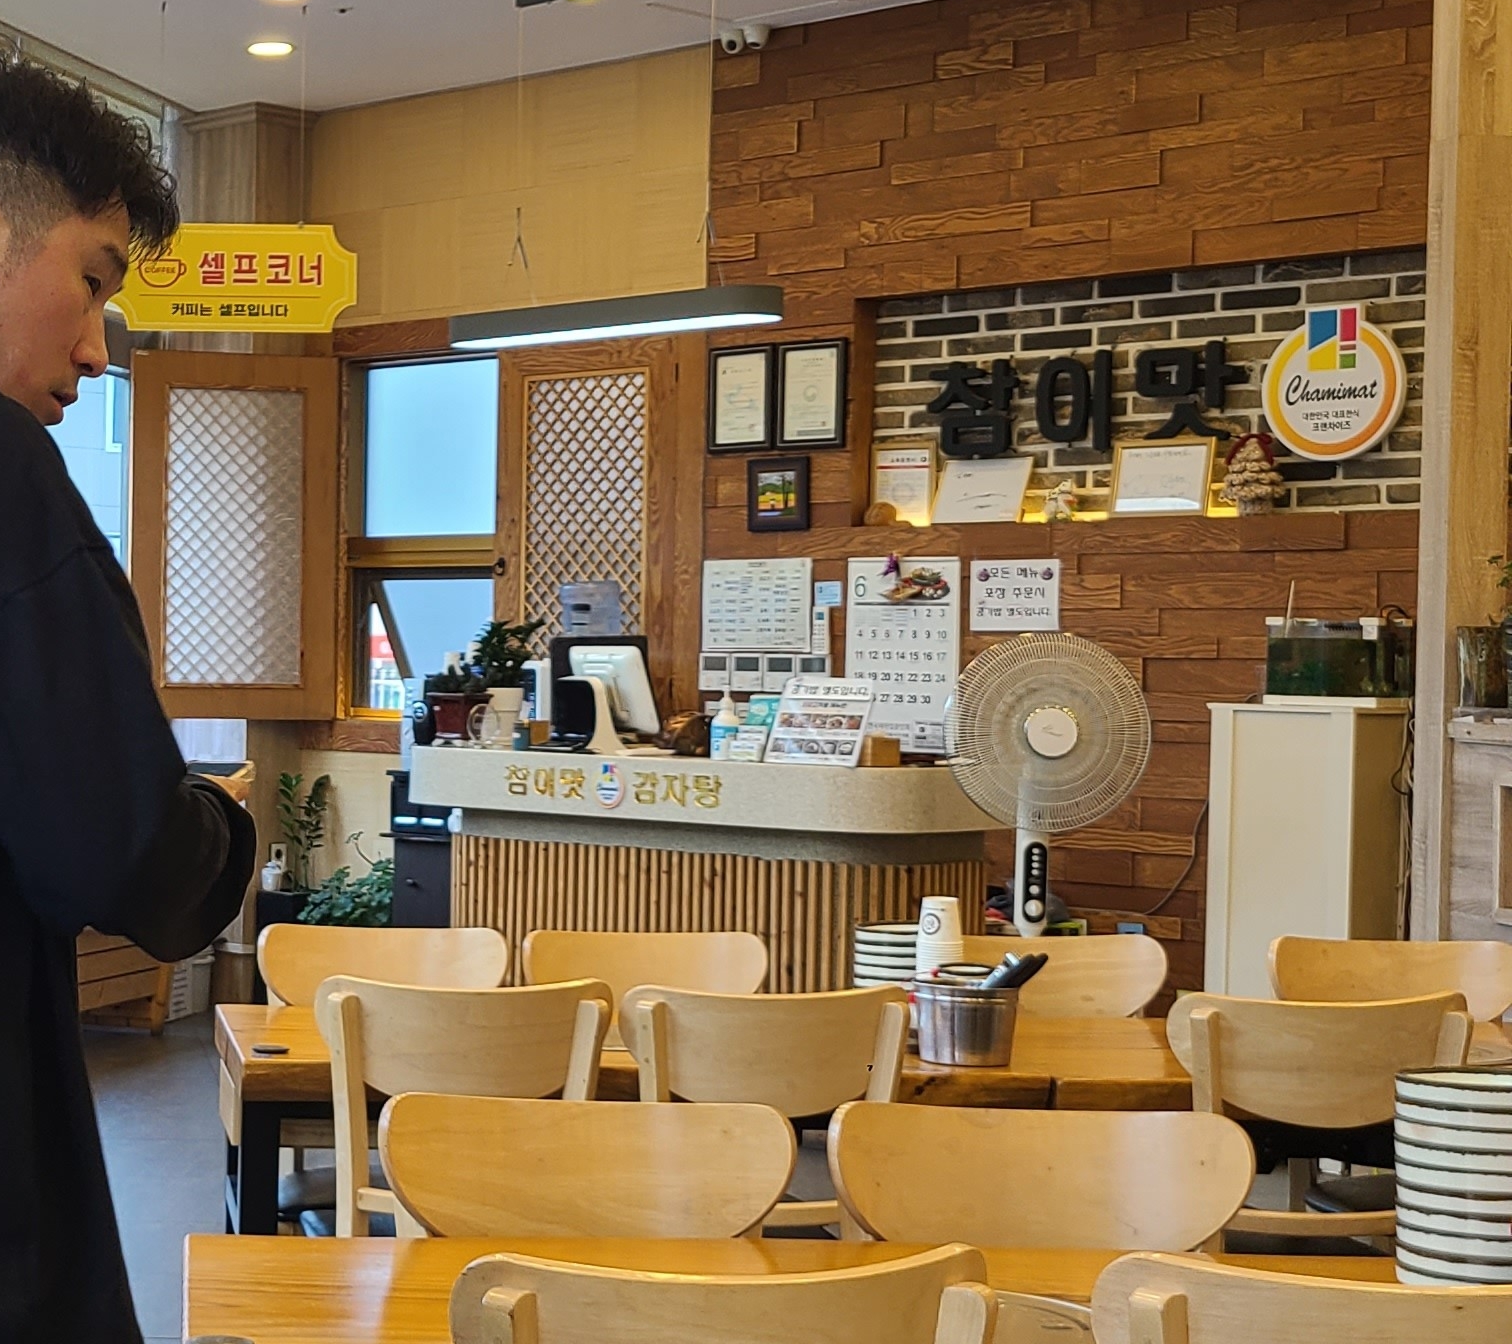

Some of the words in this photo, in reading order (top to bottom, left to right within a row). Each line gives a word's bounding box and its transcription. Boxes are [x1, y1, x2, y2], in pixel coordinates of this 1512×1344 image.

[198, 252, 323, 286] 셀프코너
[171, 302, 212, 317] 커피는
[218, 303, 289, 318] 셀프입니다
[926, 339, 1250, 457] 참이맛
[1285, 374, 1377, 407] Chamimat
[1301, 410, 1330, 421] 대한민국
[990, 567, 1010, 579] 모든
[1016, 566, 1039, 579] 메뉴
[854, 575, 867, 598] 6
[984, 587, 1006, 600] 포장
[1013, 586, 1046, 599] 주문시
[632, 770, 723, 809] 감자탕
